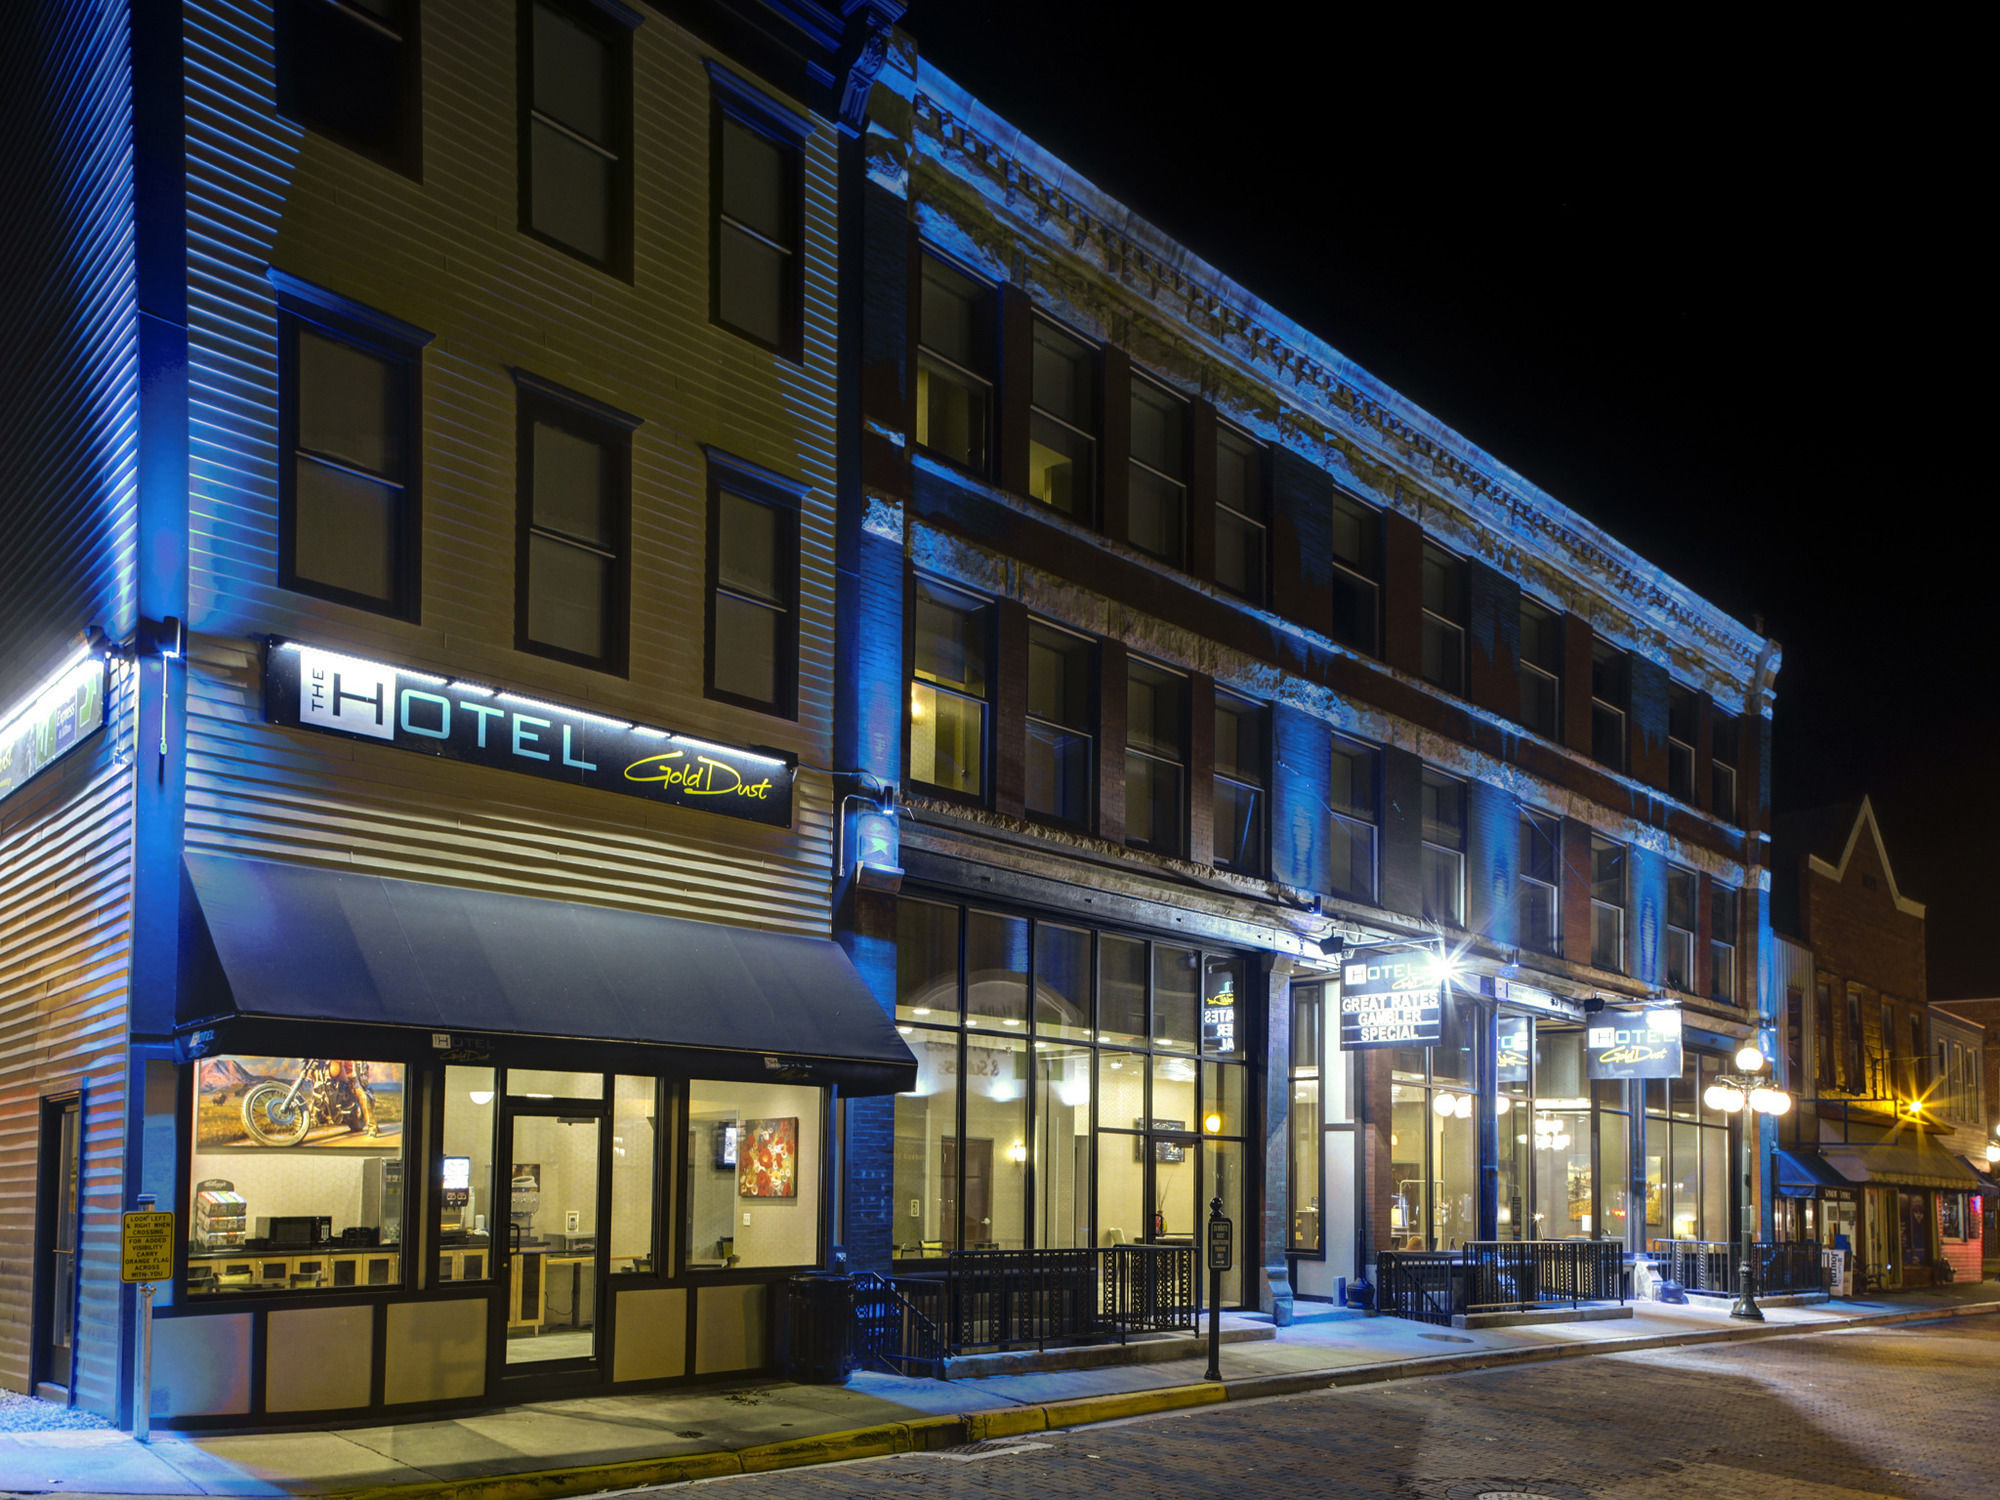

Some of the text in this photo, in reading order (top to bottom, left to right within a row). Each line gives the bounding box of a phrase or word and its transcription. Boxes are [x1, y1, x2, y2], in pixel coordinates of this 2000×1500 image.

[311, 666, 324, 712] THE
[332, 671, 598, 772] HOTEL
[623, 750, 773, 800] Gold Dust
[1352, 963, 1417, 981] HOTEL
[1342, 992, 1439, 1012] GREAT RATES
[1357, 1009, 1422, 1026] GAMBLER
[1360, 1025, 1419, 1041] SPECIAL
[1598, 1028, 1675, 1045] HOTEL
[1599, 1045, 1632, 1063] Gold
[1831, 1251, 1840, 1286] Journal
